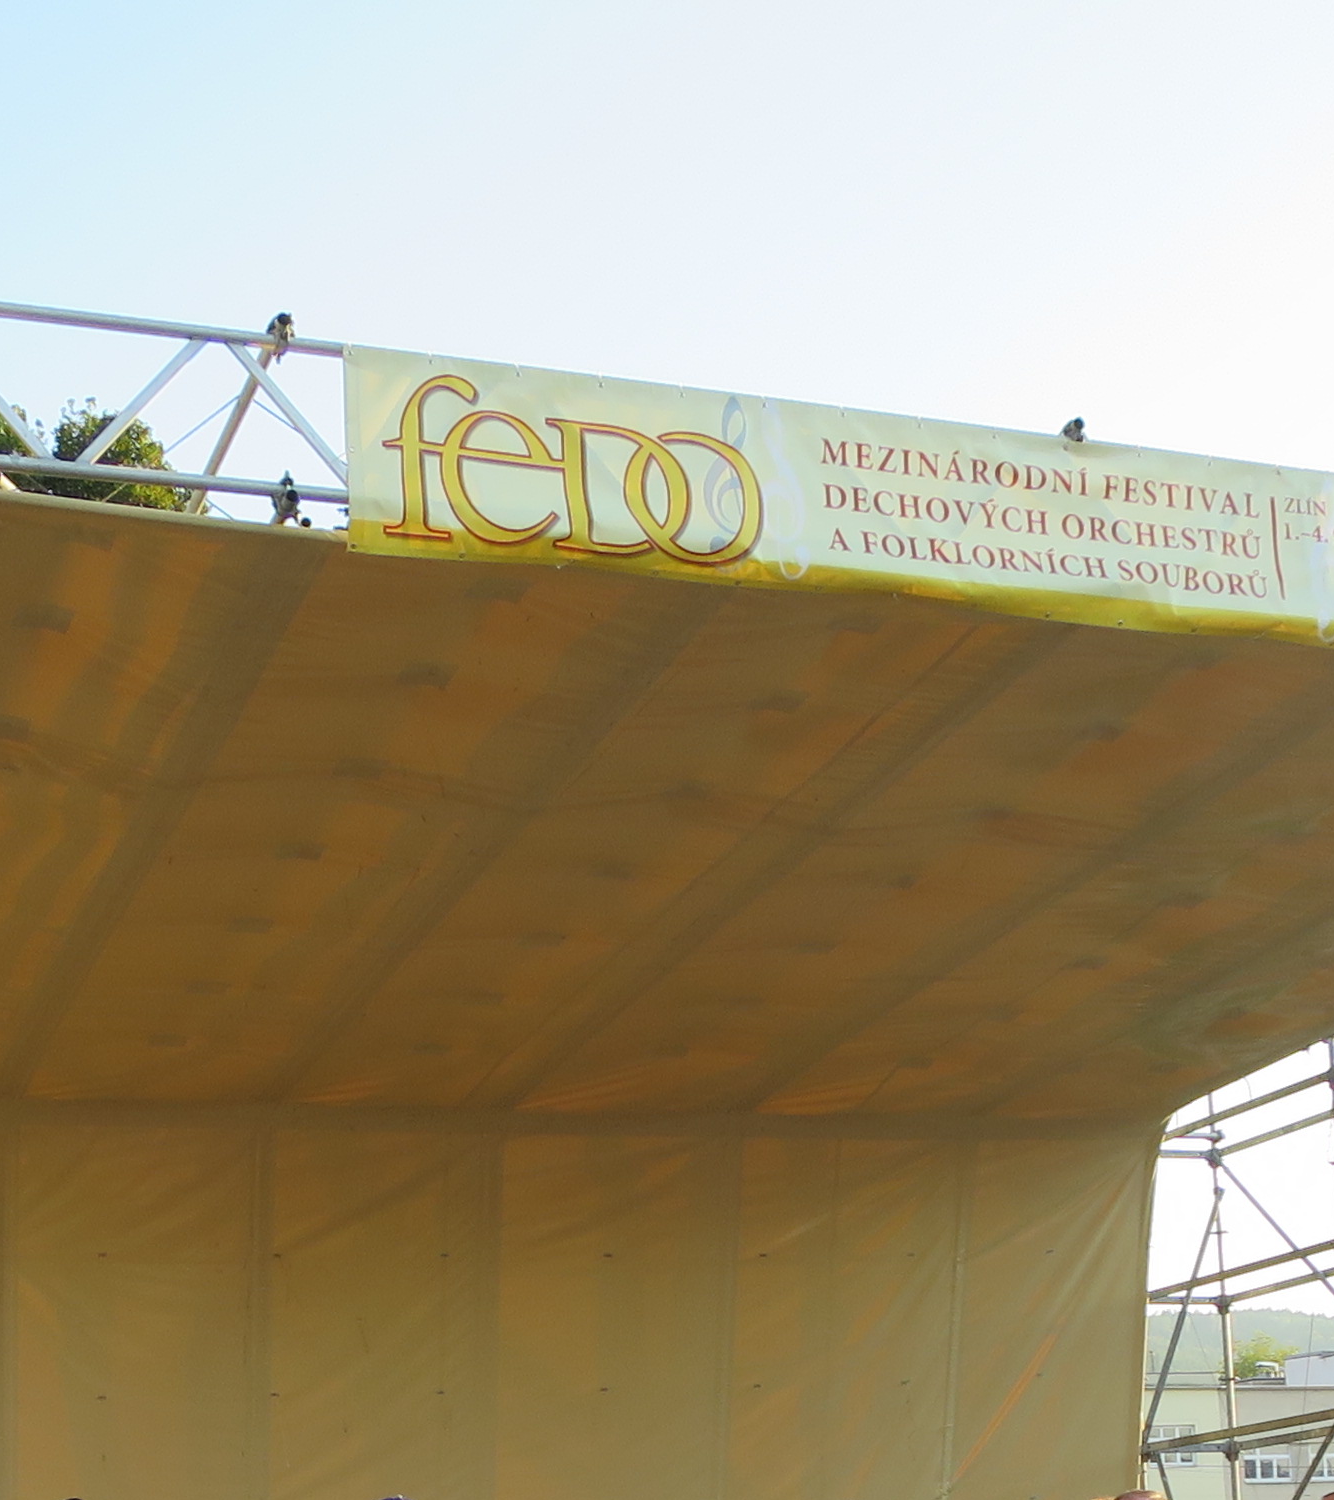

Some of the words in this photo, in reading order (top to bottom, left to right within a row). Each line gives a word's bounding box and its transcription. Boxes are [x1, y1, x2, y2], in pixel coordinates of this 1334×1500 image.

[821, 437, 1089, 497] MEZINÁRODNÍ
[1102, 473, 1261, 519] FESTIVAL
[1283, 496, 1327, 518] ZLÍN
[822, 483, 1049, 536] DECHOVÝCH
[1061, 511, 1262, 559] ORCHESTRŮ
[829, 527, 851, 552] A
[862, 530, 1107, 579] FOLKLORNÍCH
[1117, 558, 1269, 599] SOUBORŮ
